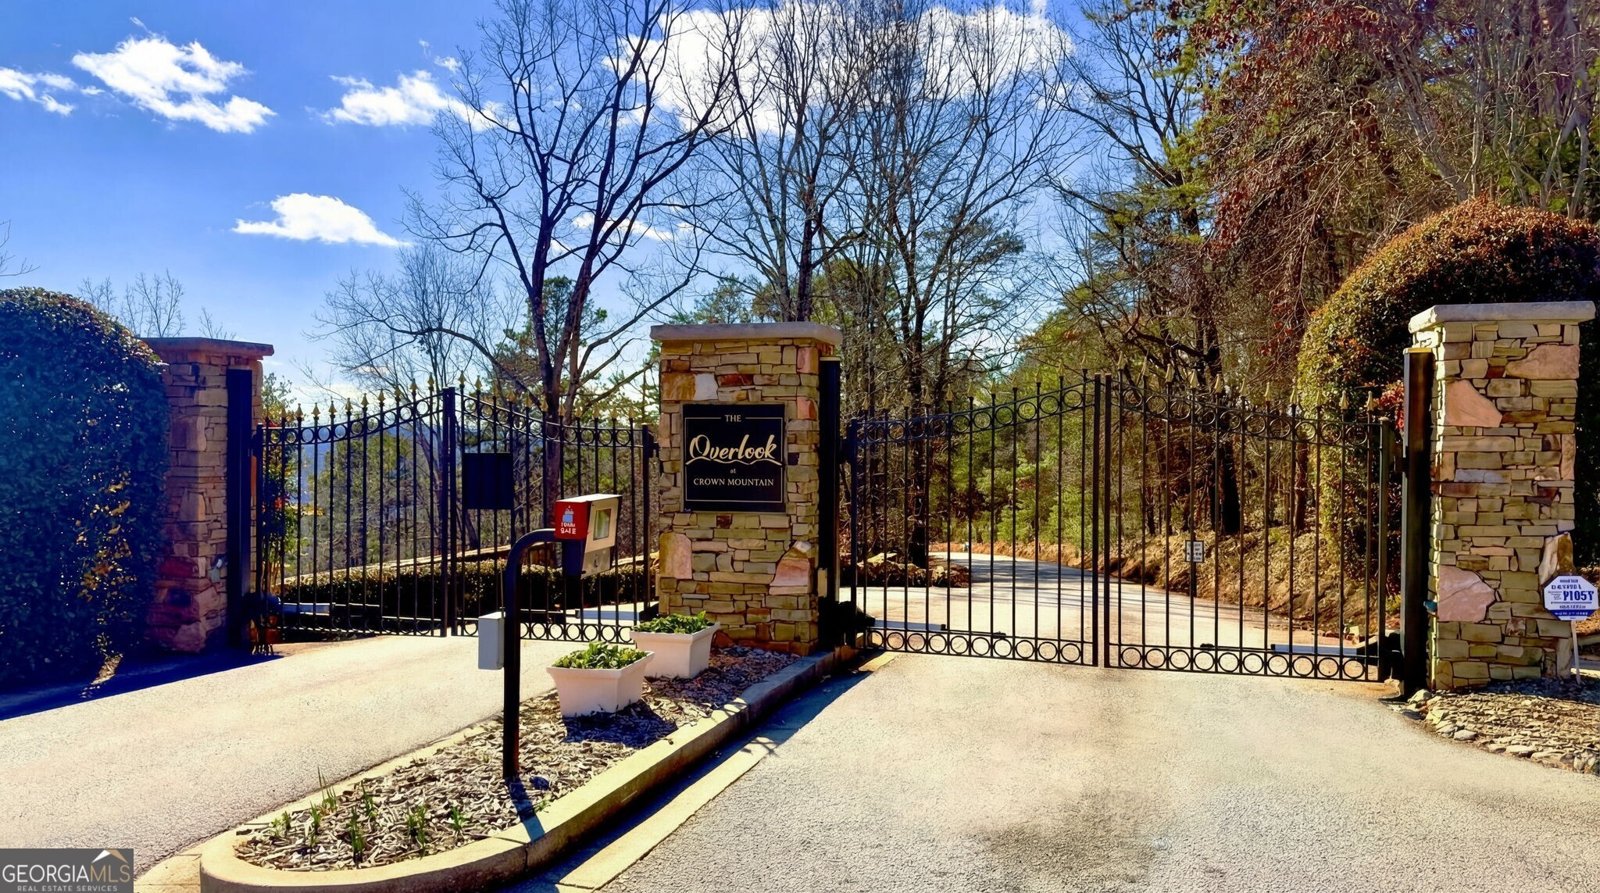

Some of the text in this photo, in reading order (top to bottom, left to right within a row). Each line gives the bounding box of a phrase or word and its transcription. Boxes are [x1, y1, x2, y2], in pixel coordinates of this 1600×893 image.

[724, 414, 742, 423] THE
[689, 434, 777, 460] Overlook
[693, 478, 774, 487] CROWN MOUNTAIN
